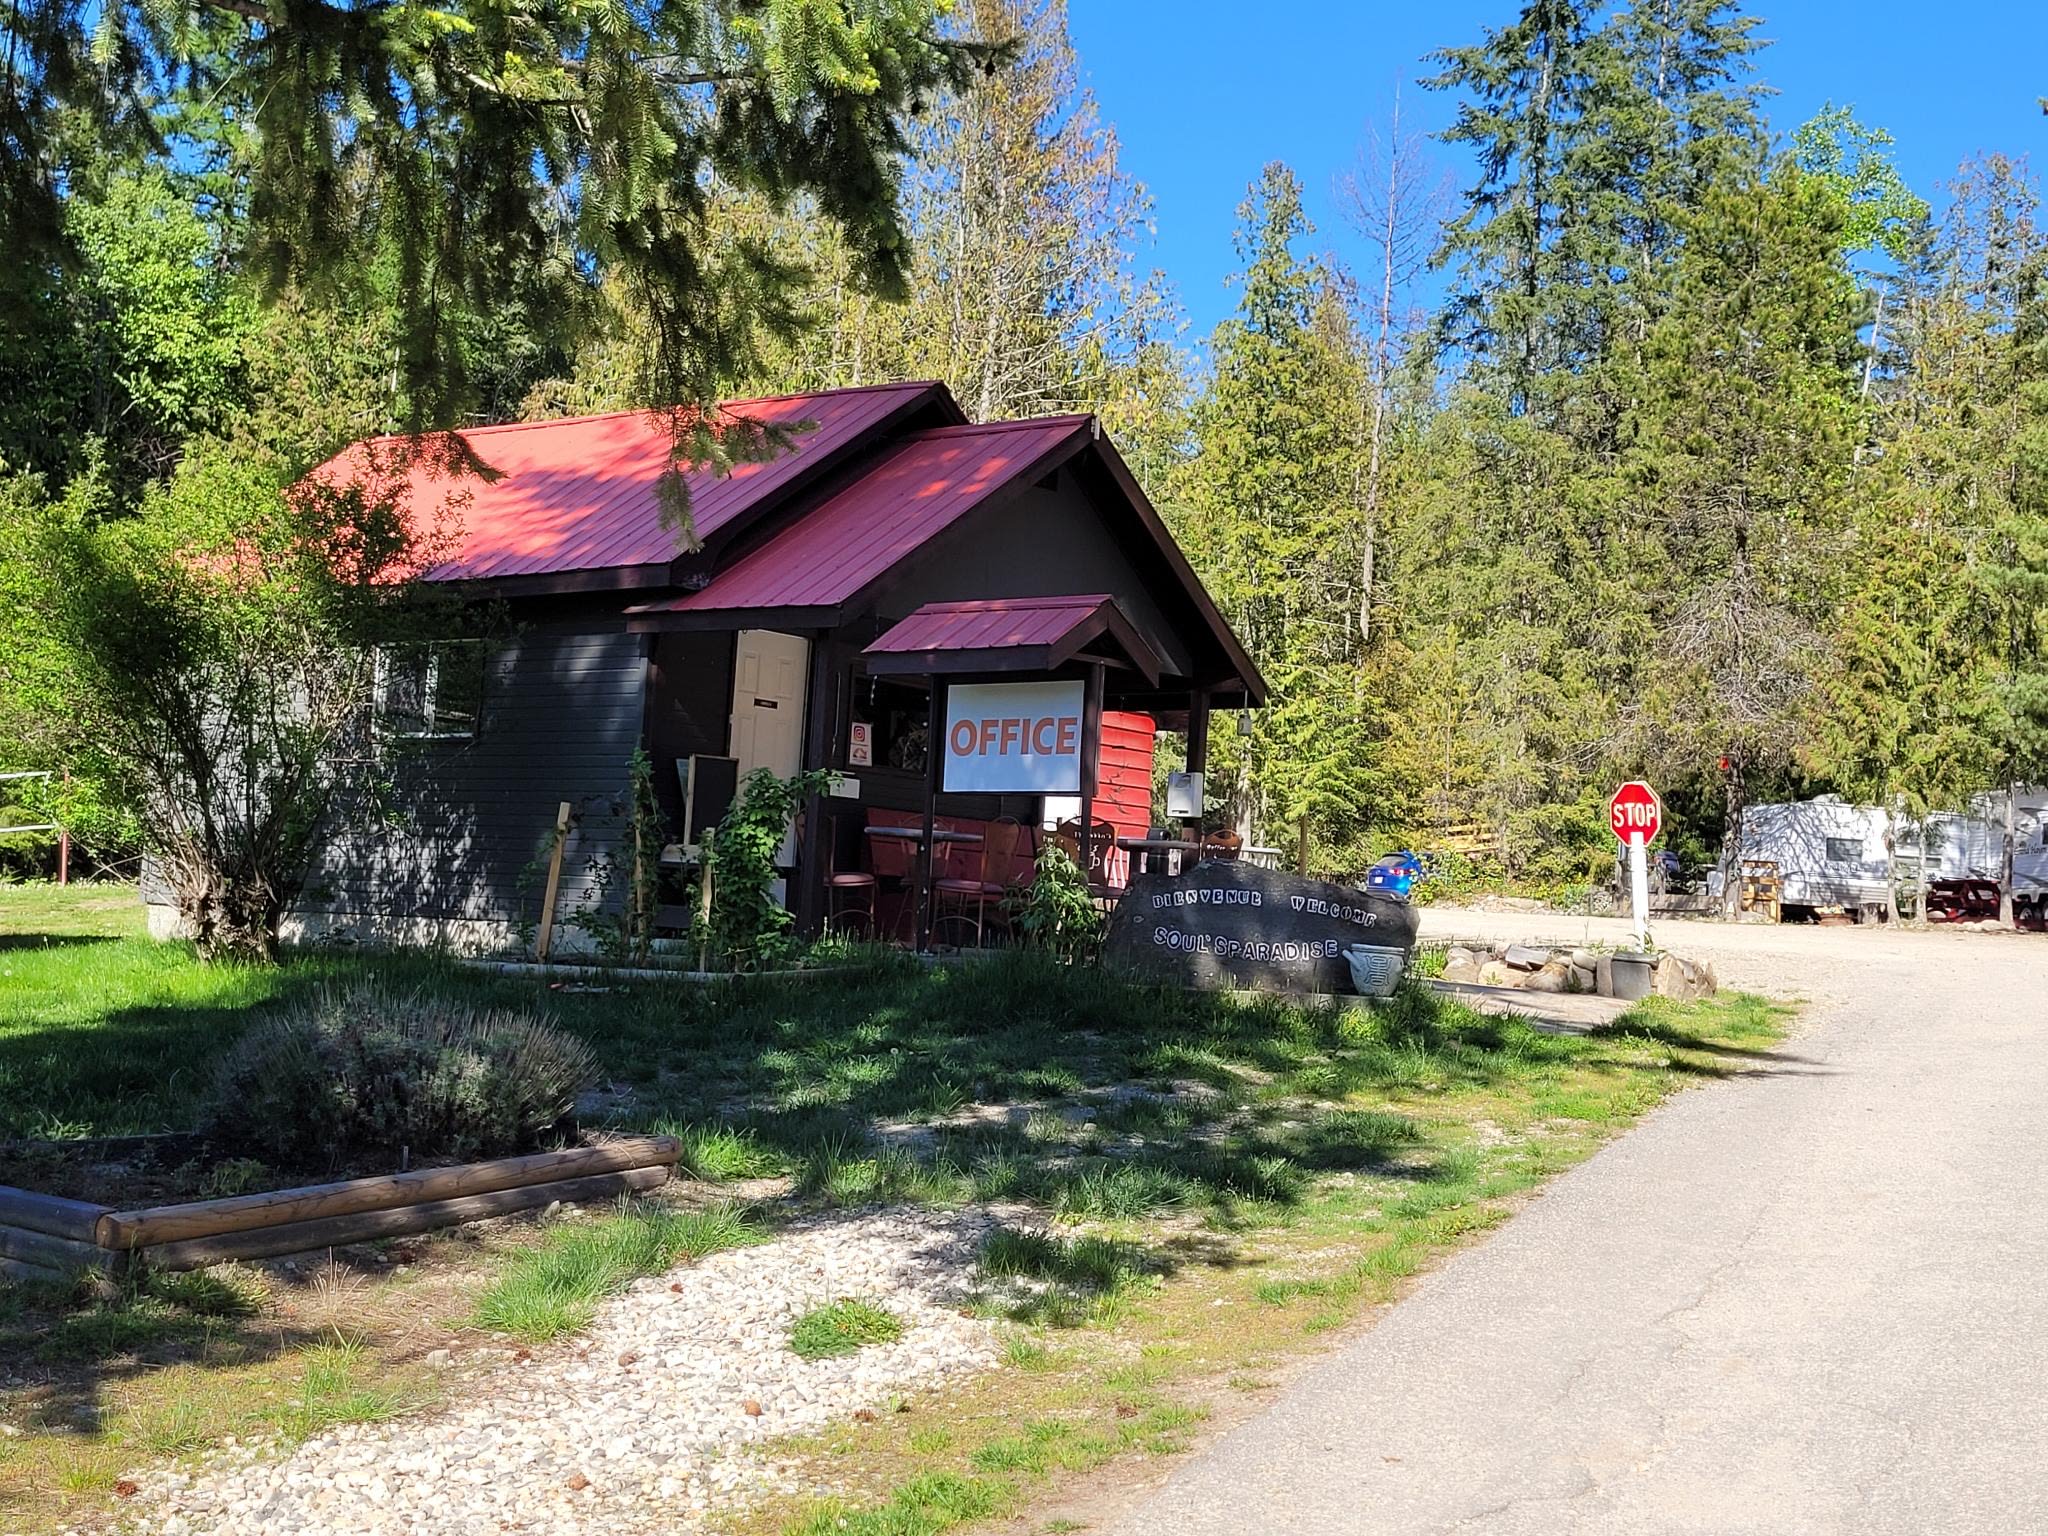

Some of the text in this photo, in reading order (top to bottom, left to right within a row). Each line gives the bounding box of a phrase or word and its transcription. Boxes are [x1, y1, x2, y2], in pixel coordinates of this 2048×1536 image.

[950, 717, 1078, 757] OFFICE
[1613, 802, 1656, 828] STOP
[1290, 895, 1378, 928] WELCOME
